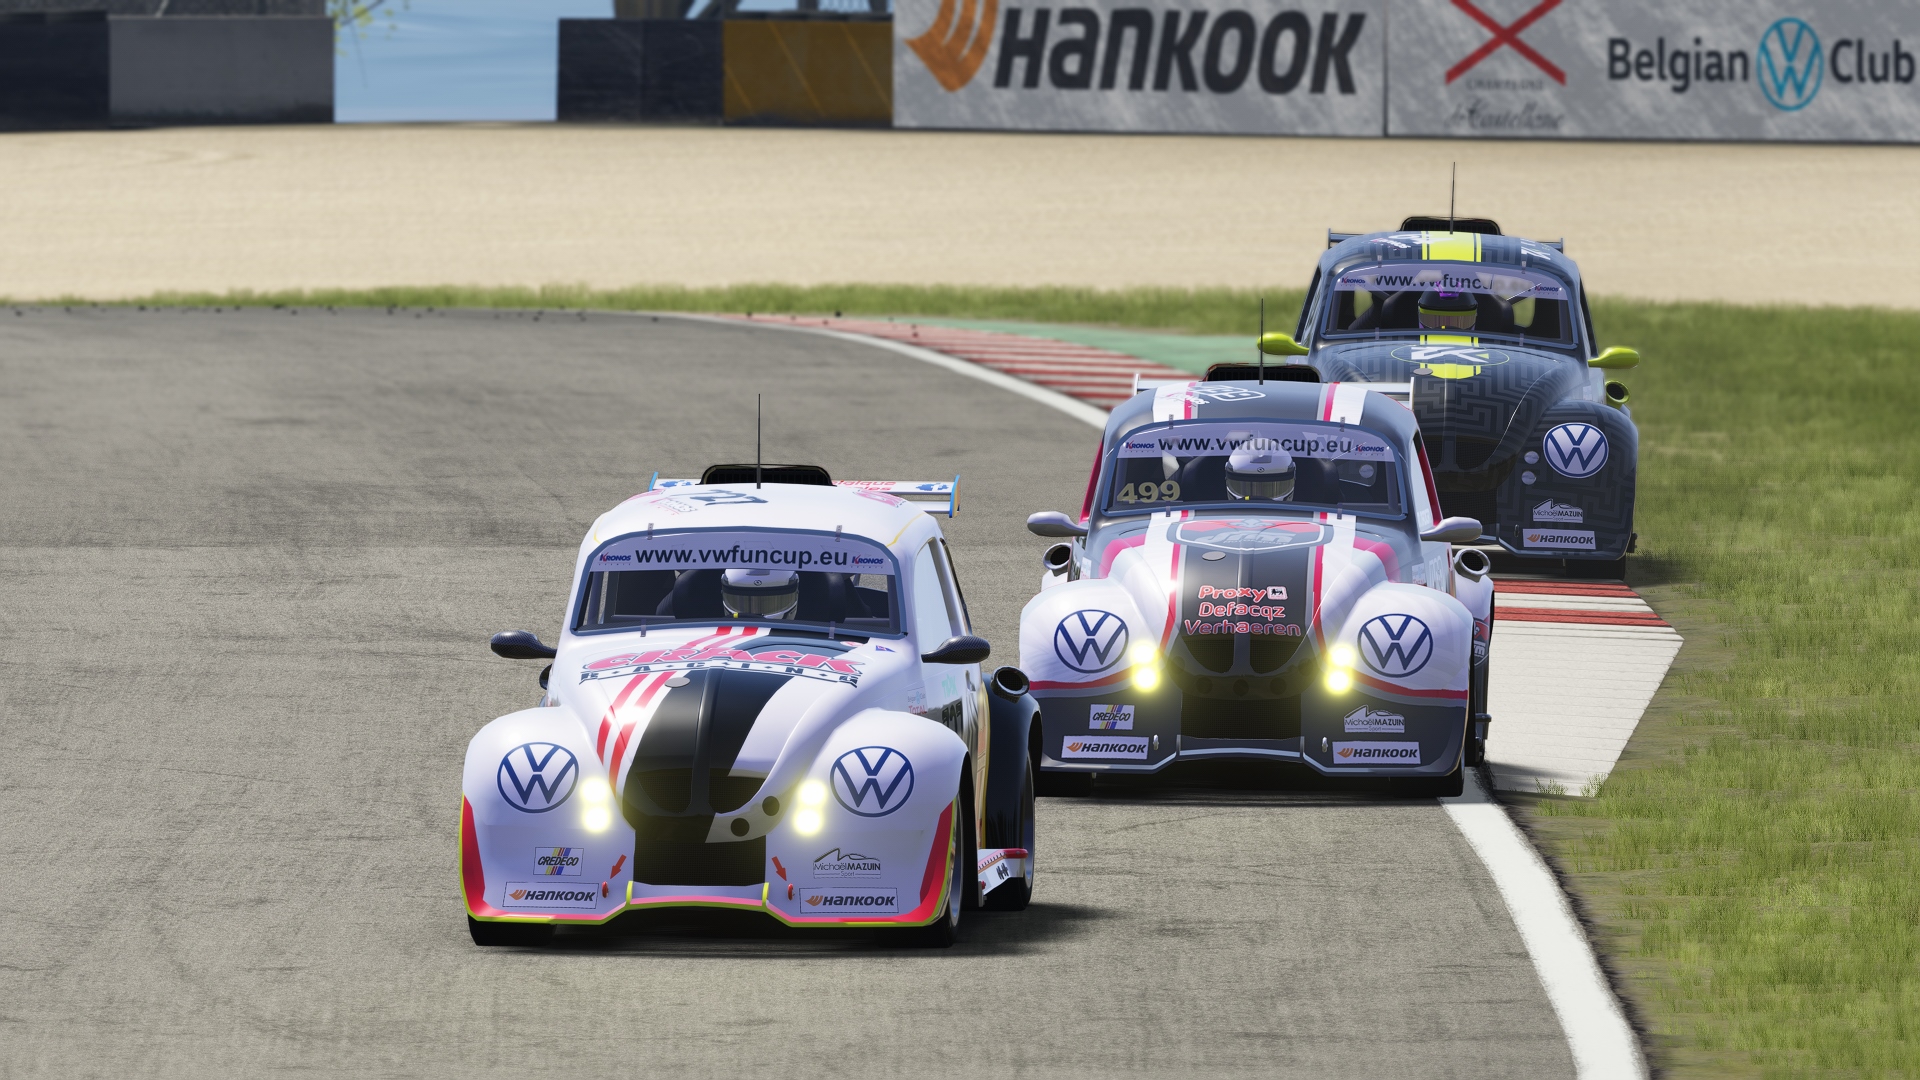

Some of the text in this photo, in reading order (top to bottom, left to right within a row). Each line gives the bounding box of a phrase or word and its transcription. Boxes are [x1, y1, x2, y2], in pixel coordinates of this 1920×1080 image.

[1608, 37, 1749, 94] Belgian
[1830, 39, 1916, 84] Club
[1116, 480, 1181, 504] 499
[635, 545, 848, 568] www.vwfuncup.eu
[1198, 585, 1267, 603] Proxy
[1198, 602, 1286, 620] Defacqz
[1184, 619, 1301, 637] Verhaeren
[1092, 712, 1131, 722] CREDECO
[537, 856, 579, 866] CREDECO
